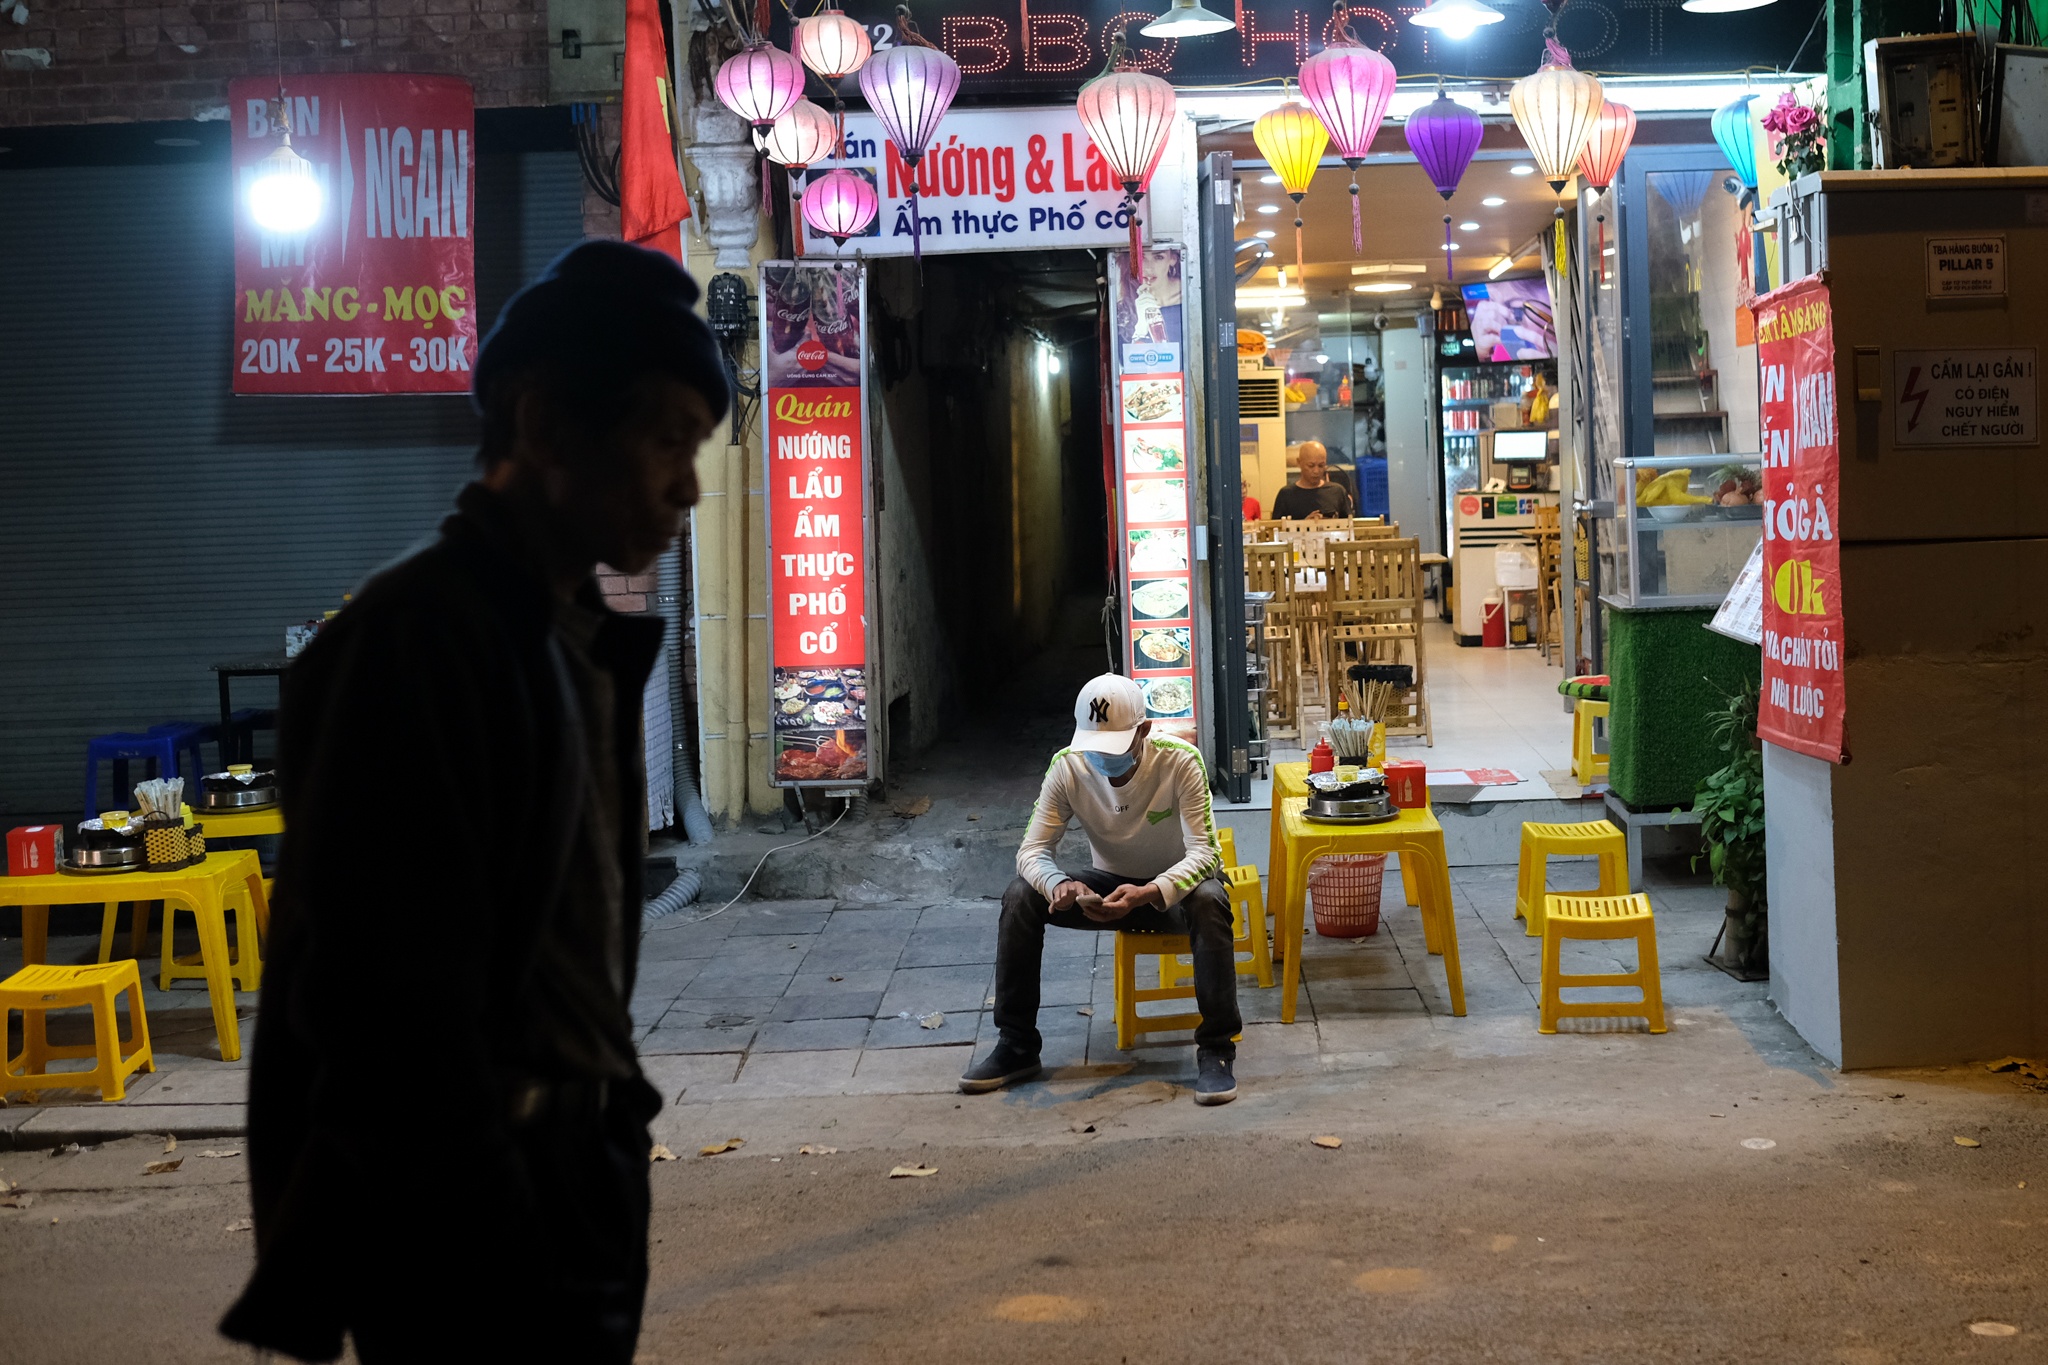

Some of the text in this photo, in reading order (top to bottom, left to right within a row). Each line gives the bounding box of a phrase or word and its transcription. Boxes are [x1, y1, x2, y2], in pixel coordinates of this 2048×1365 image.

[863, 23, 894, 51] 2
[942, 11, 1178, 75] BBQ
[1024, 133, 1056, 194] &
[364, 126, 468, 239] NGAN
[952, 210, 1018, 239] thực
[1030, 200, 1089, 232] Phố
[1939, 258, 1994, 271] PILLAR 5
[1994, 243, 2000, 254] 2
[383, 284, 467, 329] MỌC
[241, 338, 301, 374] 20K
[324, 337, 386, 372] 25K
[409, 336, 470, 372] 30K
[1931, 357, 1963, 379] CẤM
[1967, 363, 1989, 382] LẠI
[1993, 356, 2023, 378] GẦN
[776, 394, 853, 425] Quán
[1945, 400, 2019, 418] NGUY HIỂM
[1955, 385, 2009, 402] CÓ ĐIỆN
[1941, 420, 2024, 436] CHẾT NGƯỜI
[777, 431, 851, 460] NƯỚNG
[789, 466, 843, 499] LẨU
[794, 505, 840, 538] ẨM
[781, 551, 854, 581] THỰC
[789, 584, 847, 616] PHỐ
[1767, 559, 1827, 616] 0k
[800, 621, 839, 654] CỔ
[1814, 627, 1839, 671] TỎI
[1793, 680, 1825, 724] LUỘC
[1114, 804, 1130, 813] OFF
